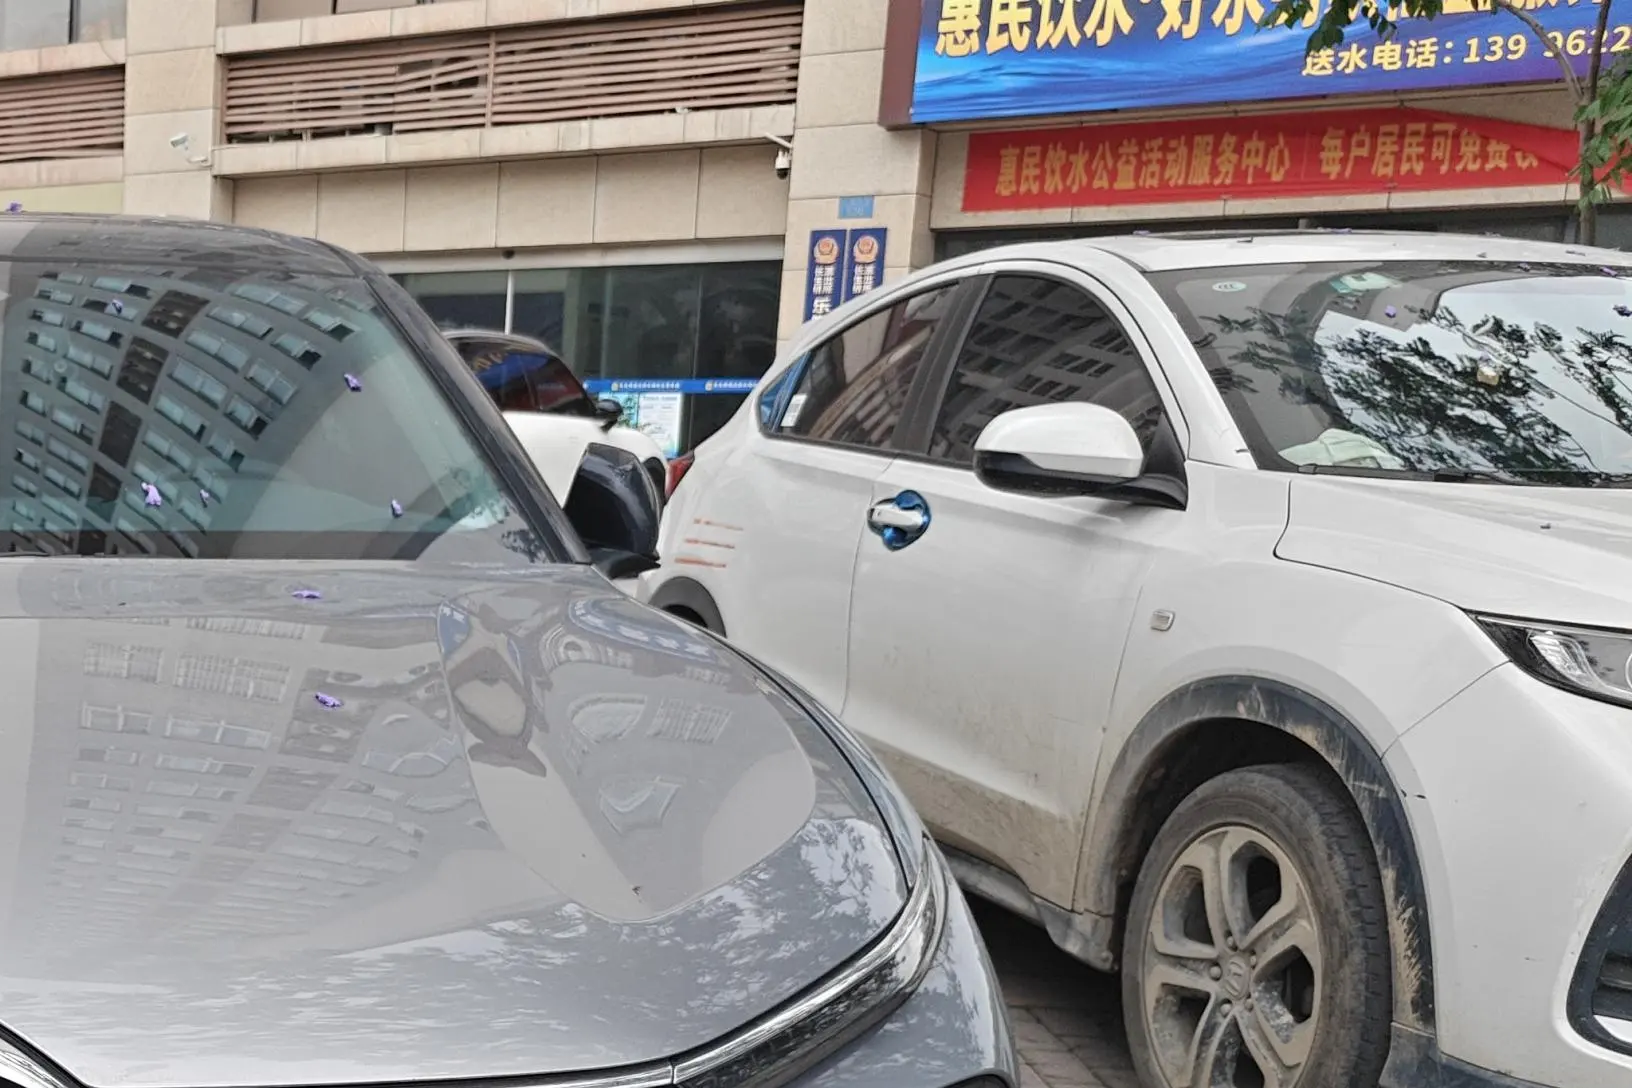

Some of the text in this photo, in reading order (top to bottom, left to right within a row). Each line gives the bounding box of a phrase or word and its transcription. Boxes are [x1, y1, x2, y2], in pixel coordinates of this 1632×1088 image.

[995, 129, 1292, 197] 惠民饮水公益活动服务中心
